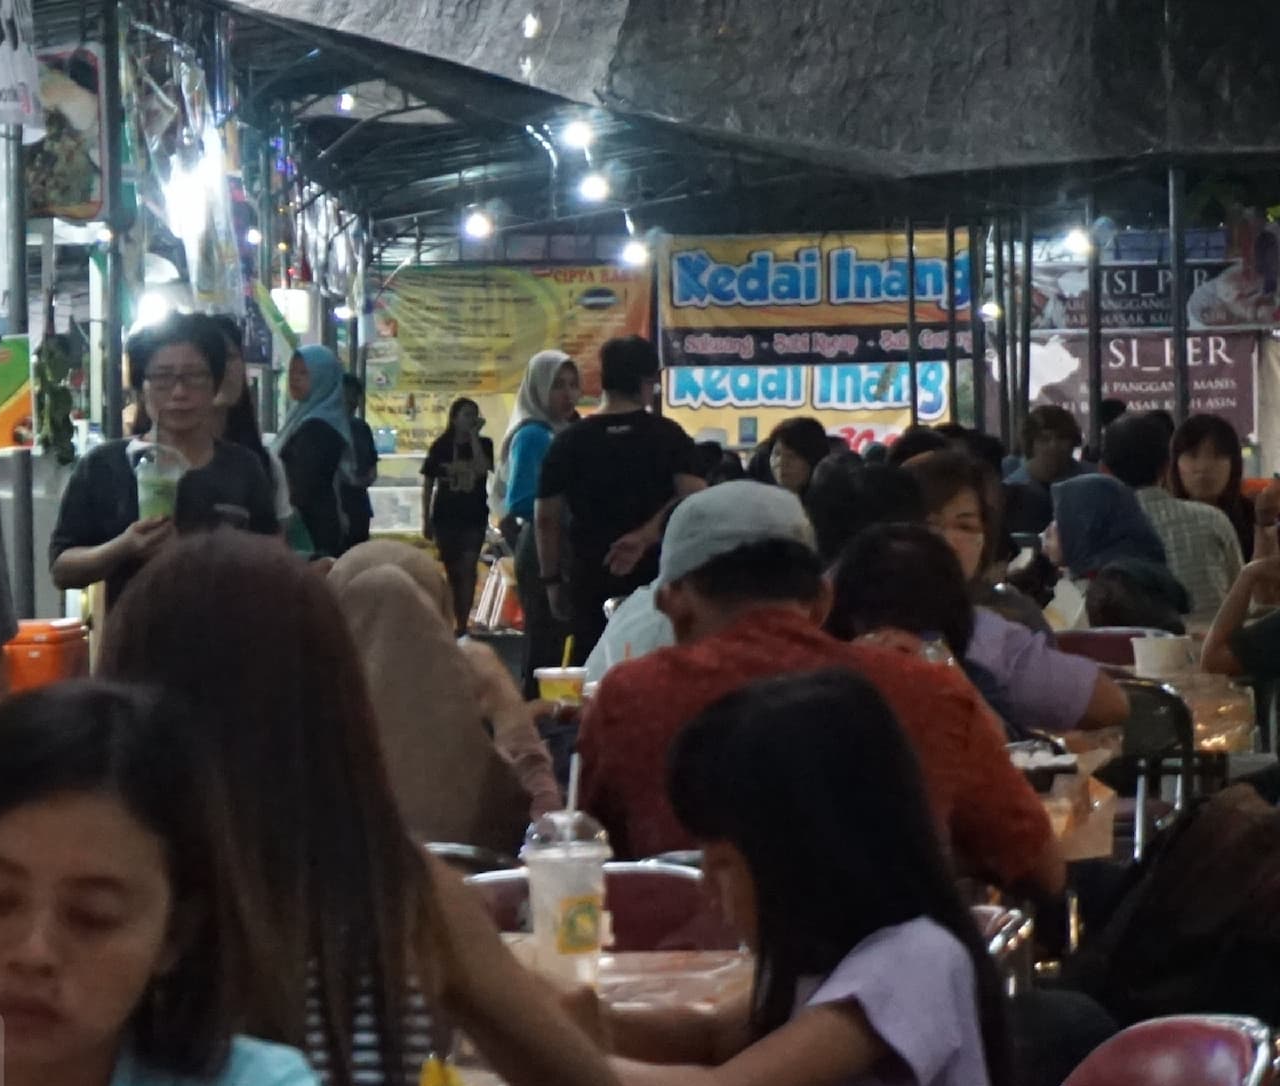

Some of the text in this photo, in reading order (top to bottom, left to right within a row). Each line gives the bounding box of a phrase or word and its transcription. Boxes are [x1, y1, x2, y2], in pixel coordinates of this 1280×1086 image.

[674, 248, 971, 310] Kedai Inang
[670, 366, 806, 409] Kedai
[1112, 380, 1176, 393] PANGGAN
